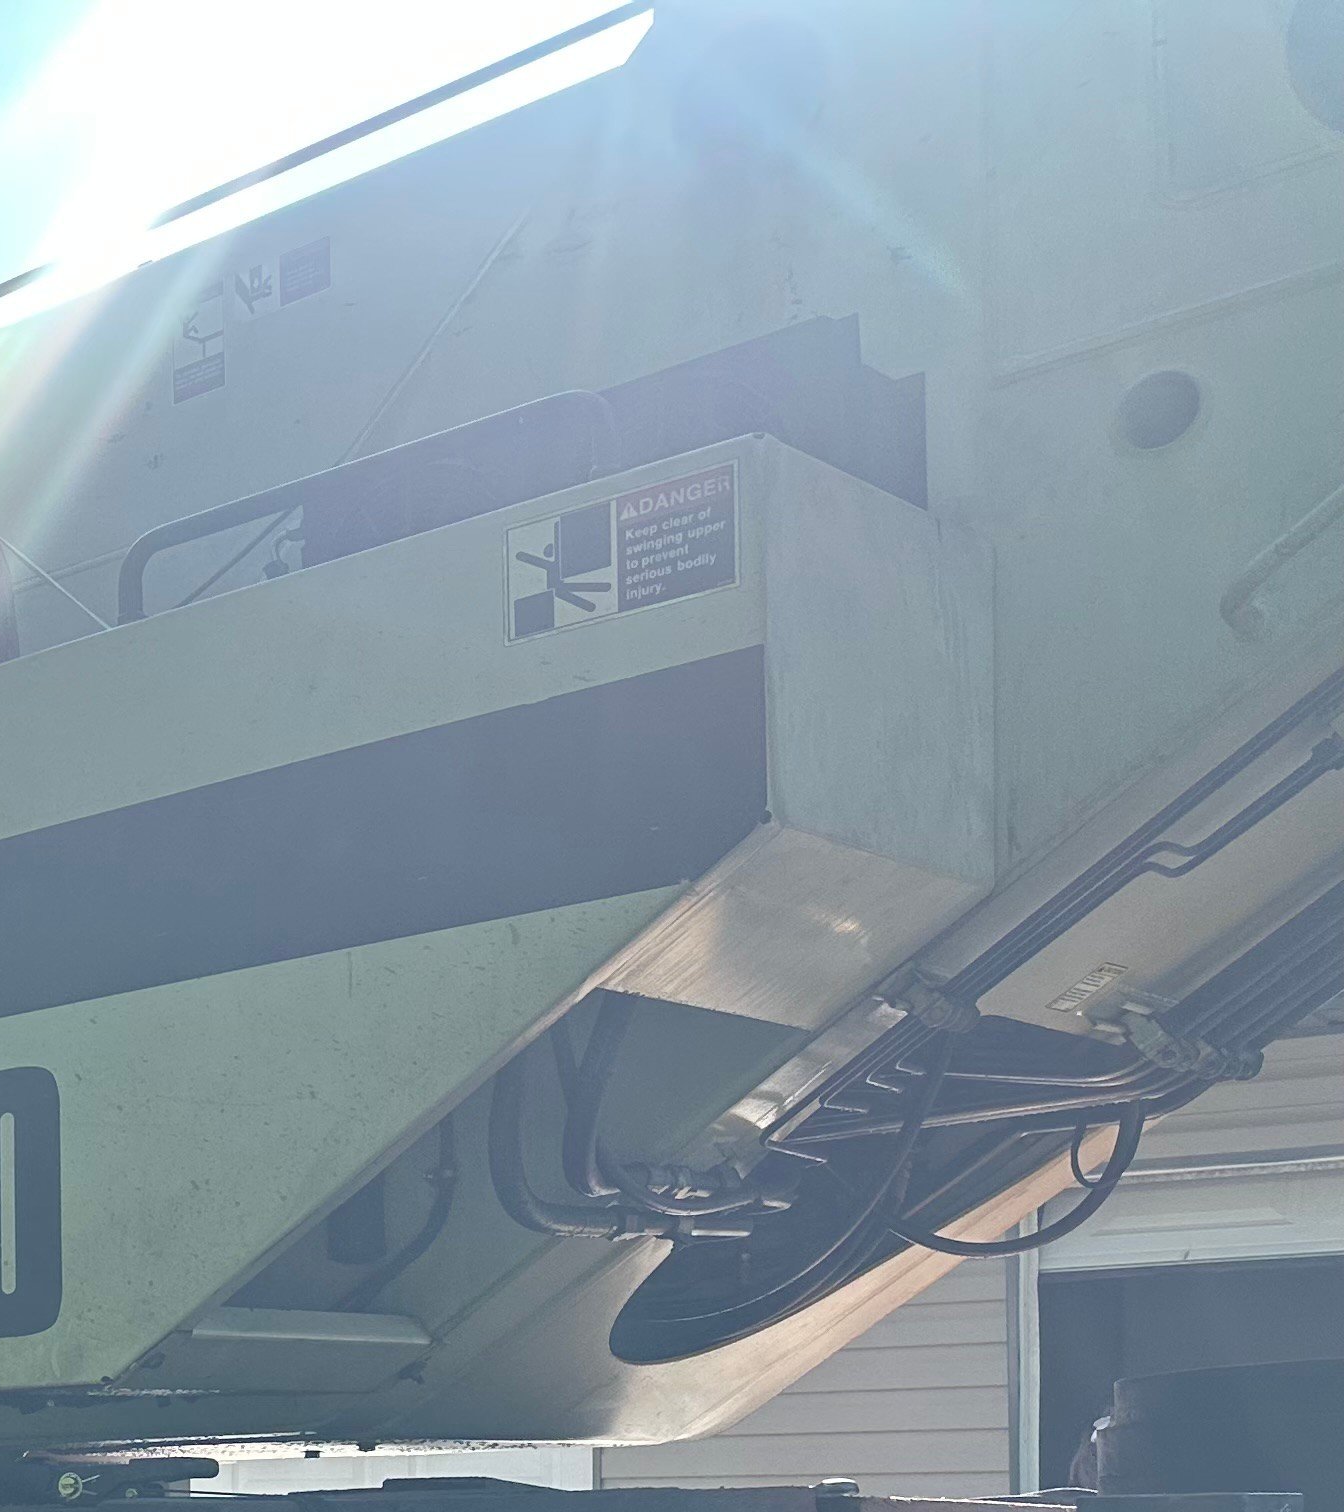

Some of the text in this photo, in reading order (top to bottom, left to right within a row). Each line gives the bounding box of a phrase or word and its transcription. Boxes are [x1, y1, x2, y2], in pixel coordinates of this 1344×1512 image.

[639, 475, 731, 514] DANGER
[625, 506, 711, 541] Keep clear of
[625, 520, 726, 555] swinging upper
[626, 544, 689, 570] to prevent
[626, 553, 717, 585] serious bodily
[626, 582, 667, 601] injury.
